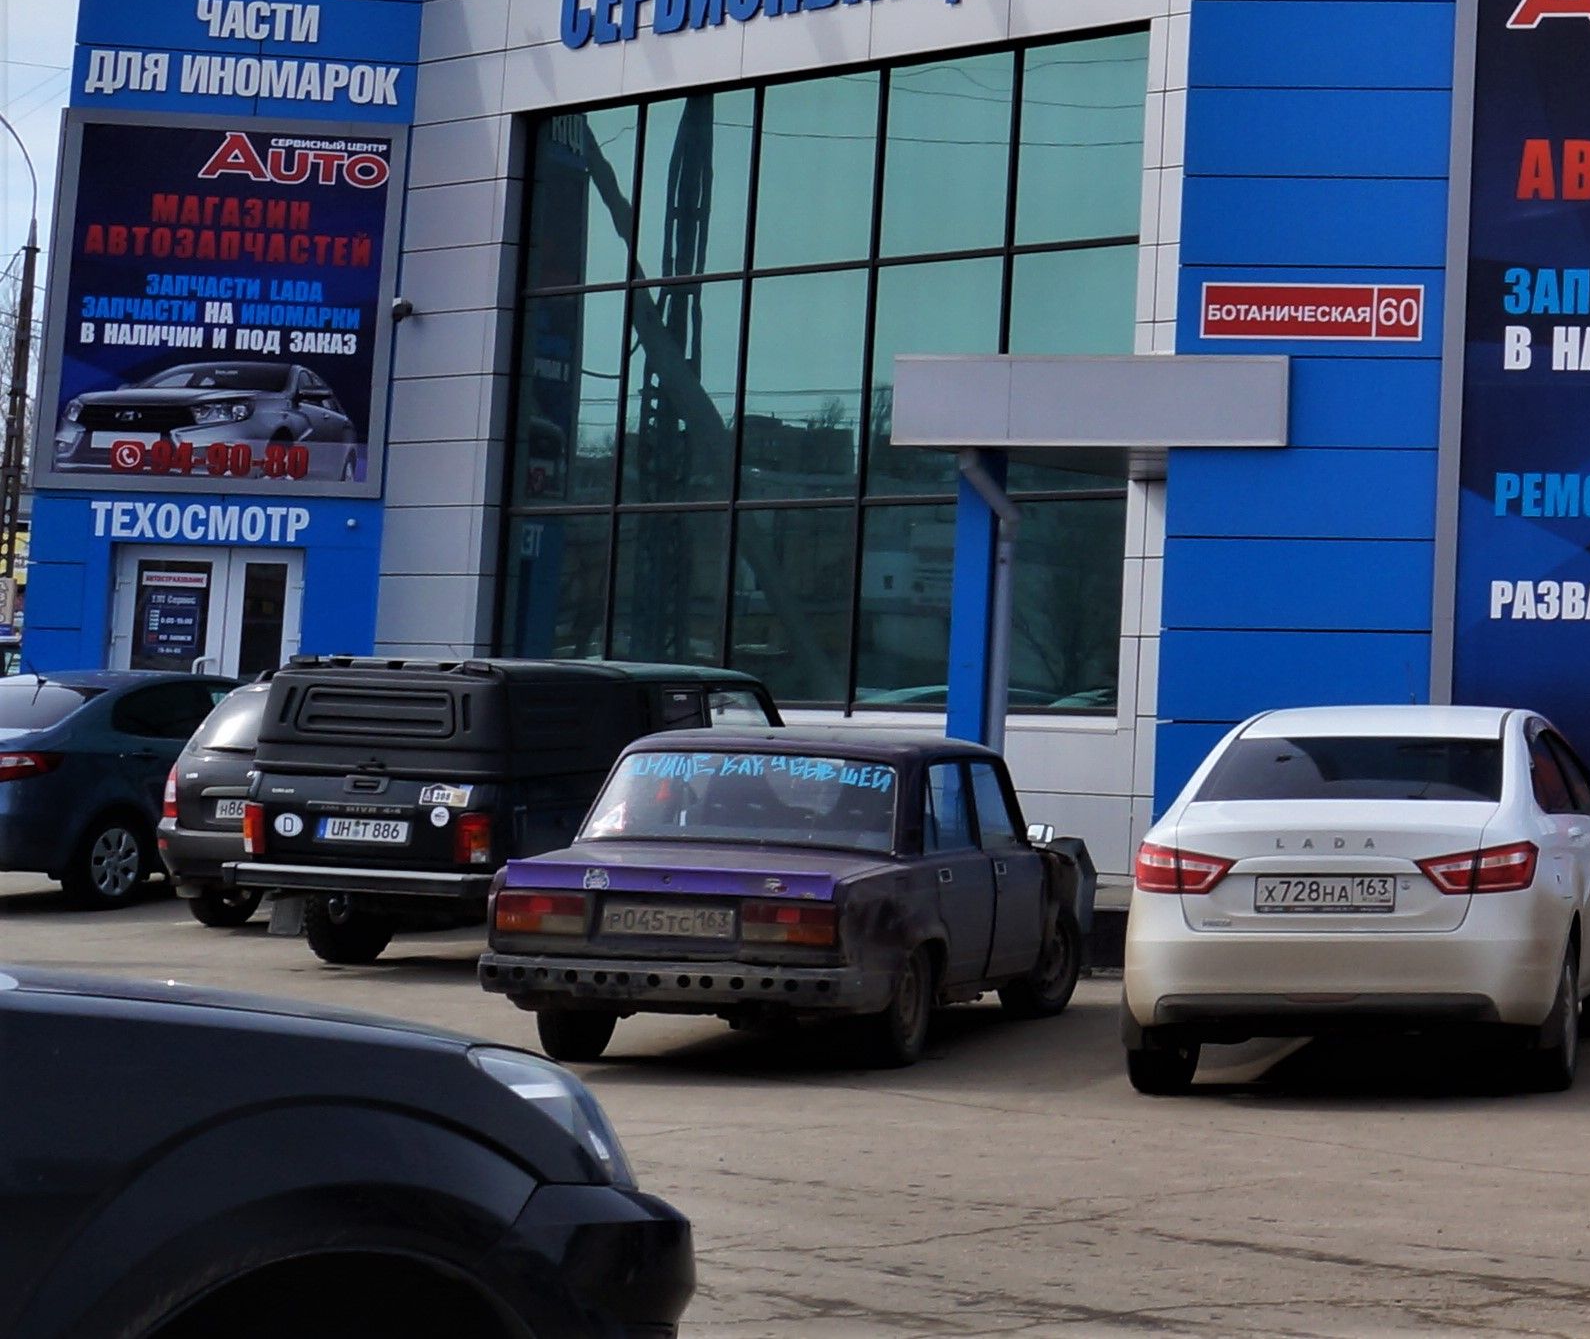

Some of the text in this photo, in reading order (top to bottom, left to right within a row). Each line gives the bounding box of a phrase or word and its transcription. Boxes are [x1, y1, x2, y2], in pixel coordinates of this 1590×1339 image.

[84, 49, 401, 105] ДЛЯ ИНОМАРОК
[271, 138, 388, 153] СЕРВИСНЫЙ ЦЕНТР
[151, 193, 311, 229] МАГАЗИН
[84, 224, 372, 268] АВТОЗАПЧАСТЕЙ
[146, 273, 324, 303] ЗАПЧАСТИ LADA
[81, 296, 361, 330] ЗАПЧАСТИ НА ИНОМАРКИ
[1207, 297, 1418, 326] БОТАНИЧЕСКАЯ 60
[80, 323, 358, 355] В НАЛИЧИИ И ПОД ЗАКАЗ
[1503, 325, 1532, 371] В
[150, 440, 310, 480] 94-90-80
[91, 500, 311, 543] ТЕХОСМОТР
[283, 816, 294, 833] D
[331, 820, 352, 837] UH
[373, 823, 400, 839] 886
[1275, 837, 1376, 849] LADA
[1356, 879, 1389, 896] 163
